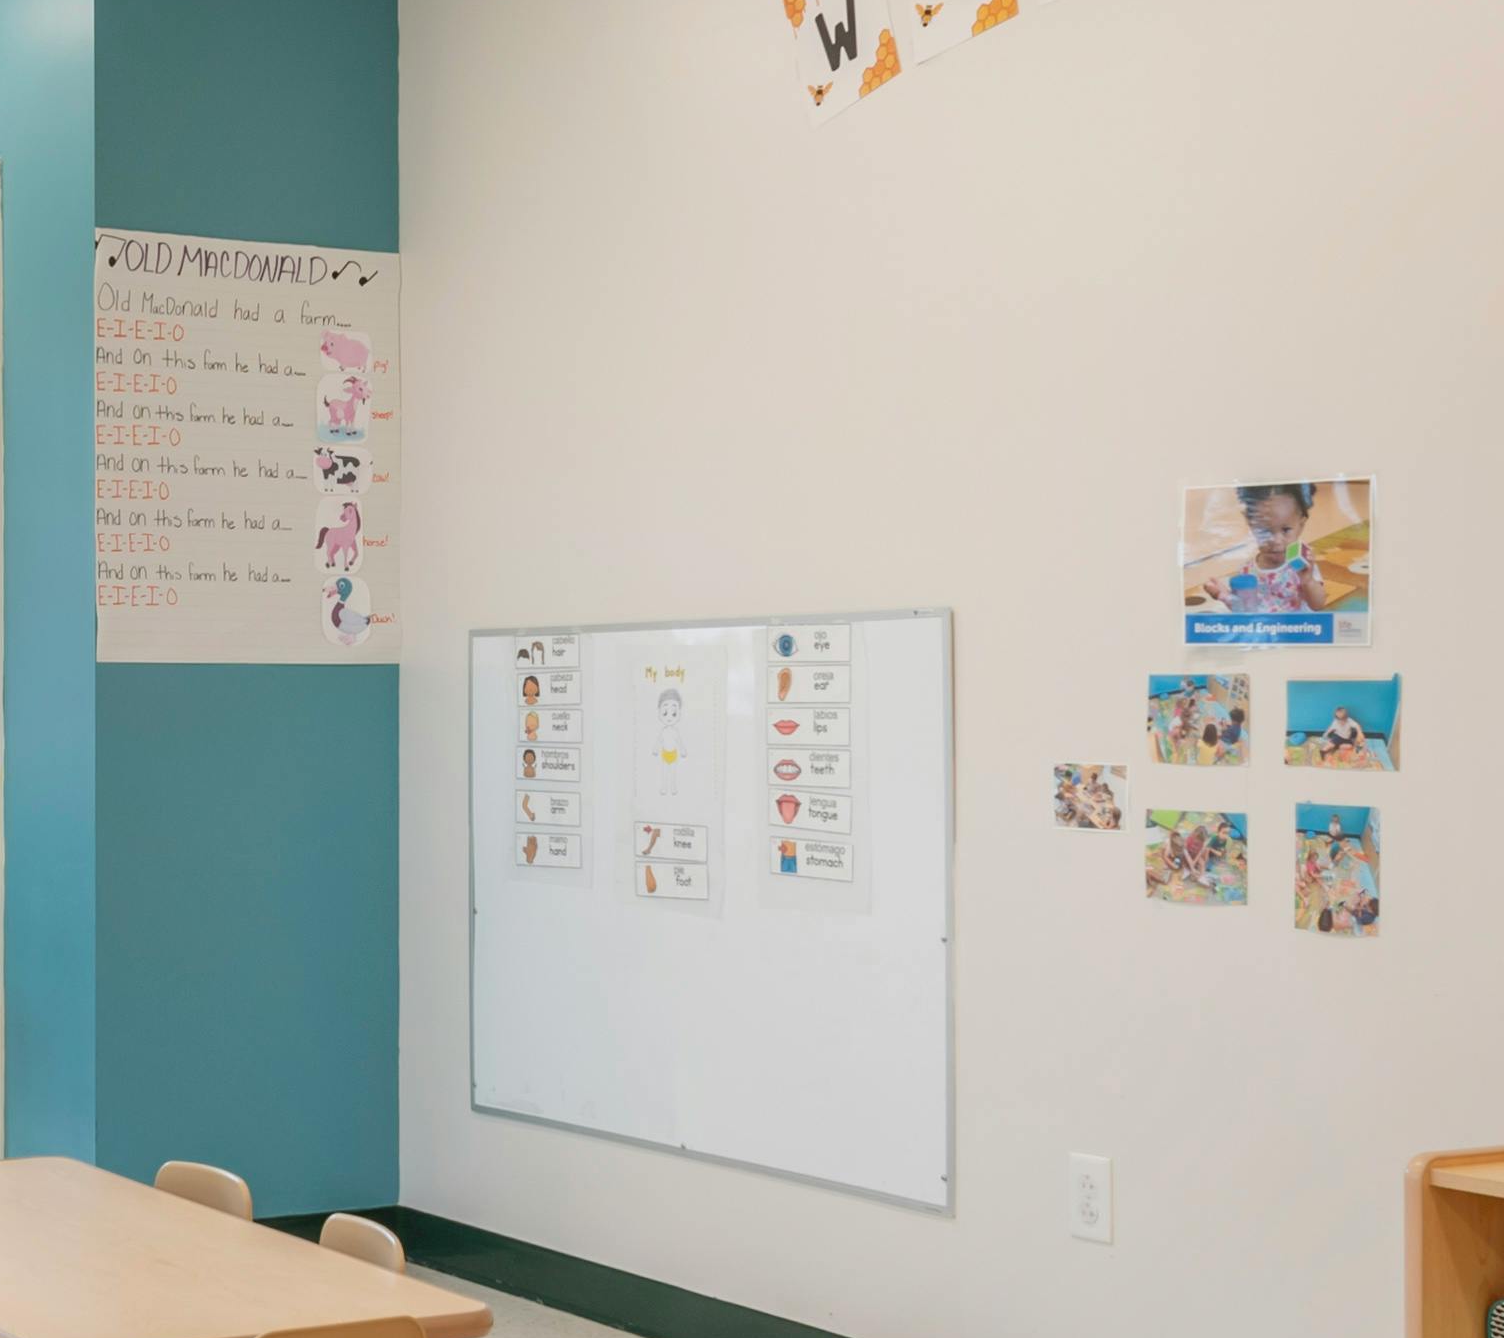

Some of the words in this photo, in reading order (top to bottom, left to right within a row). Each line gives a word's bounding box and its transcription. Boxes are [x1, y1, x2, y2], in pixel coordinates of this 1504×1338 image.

[125, 239, 172, 274] OLD
[177, 244, 328, 285] MACDONALD
[97, 282, 131, 311] Old
[141, 291, 219, 319] MacDonald
[233, 299, 260, 322] had
[273, 310, 286, 323] a
[95, 346, 123, 364] And
[162, 350, 197, 370] this
[203, 349, 228, 370] farm
[235, 355, 250, 373] he
[258, 356, 279, 374] had
[96, 400, 123, 418] And
[132, 404, 151, 419] on
[155, 404, 185, 422] this
[190, 402, 216, 423] farm
[222, 406, 237, 424] he
[243, 408, 265, 426] had
[96, 453, 124, 472] And
[132, 457, 150, 472] on
[157, 455, 189, 475] this
[193, 455, 226, 476] farm
[233, 460, 249, 477] he
[258, 458, 279, 479] had
[96, 508, 122, 526] And
[129, 511, 147, 527] on
[154, 510, 183, 529] this
[187, 509, 216, 528] farm
[222, 512, 237, 530] he
[244, 511, 265, 530] had
[362, 535, 390, 547] horse!
[97, 561, 124, 580] And
[130, 564, 148, 580] on
[156, 564, 182, 581] this
[188, 563, 217, 582] farm
[223, 562, 238, 582] he
[248, 564, 269, 583] had
[1194, 622, 1230, 634] Blocks
[1232, 622, 1254, 634] and
[1256, 621, 1322, 636] Engineering
[814, 640, 830, 652] eye
[644, 666, 658, 682] My
[664, 665, 686, 683] body
[550, 683, 568, 694] head
[814, 681, 830, 691] ear
[552, 722, 569, 732] neck
[813, 720, 828, 735] lips
[541, 760, 575, 772] shoulders
[810, 763, 835, 776] teeth
[808, 808, 838, 823] tongue
[673, 838, 692, 850] knee
[548, 846, 567, 857] hand
[805, 855, 844, 869] stomach
[676, 874, 692, 887] foot
